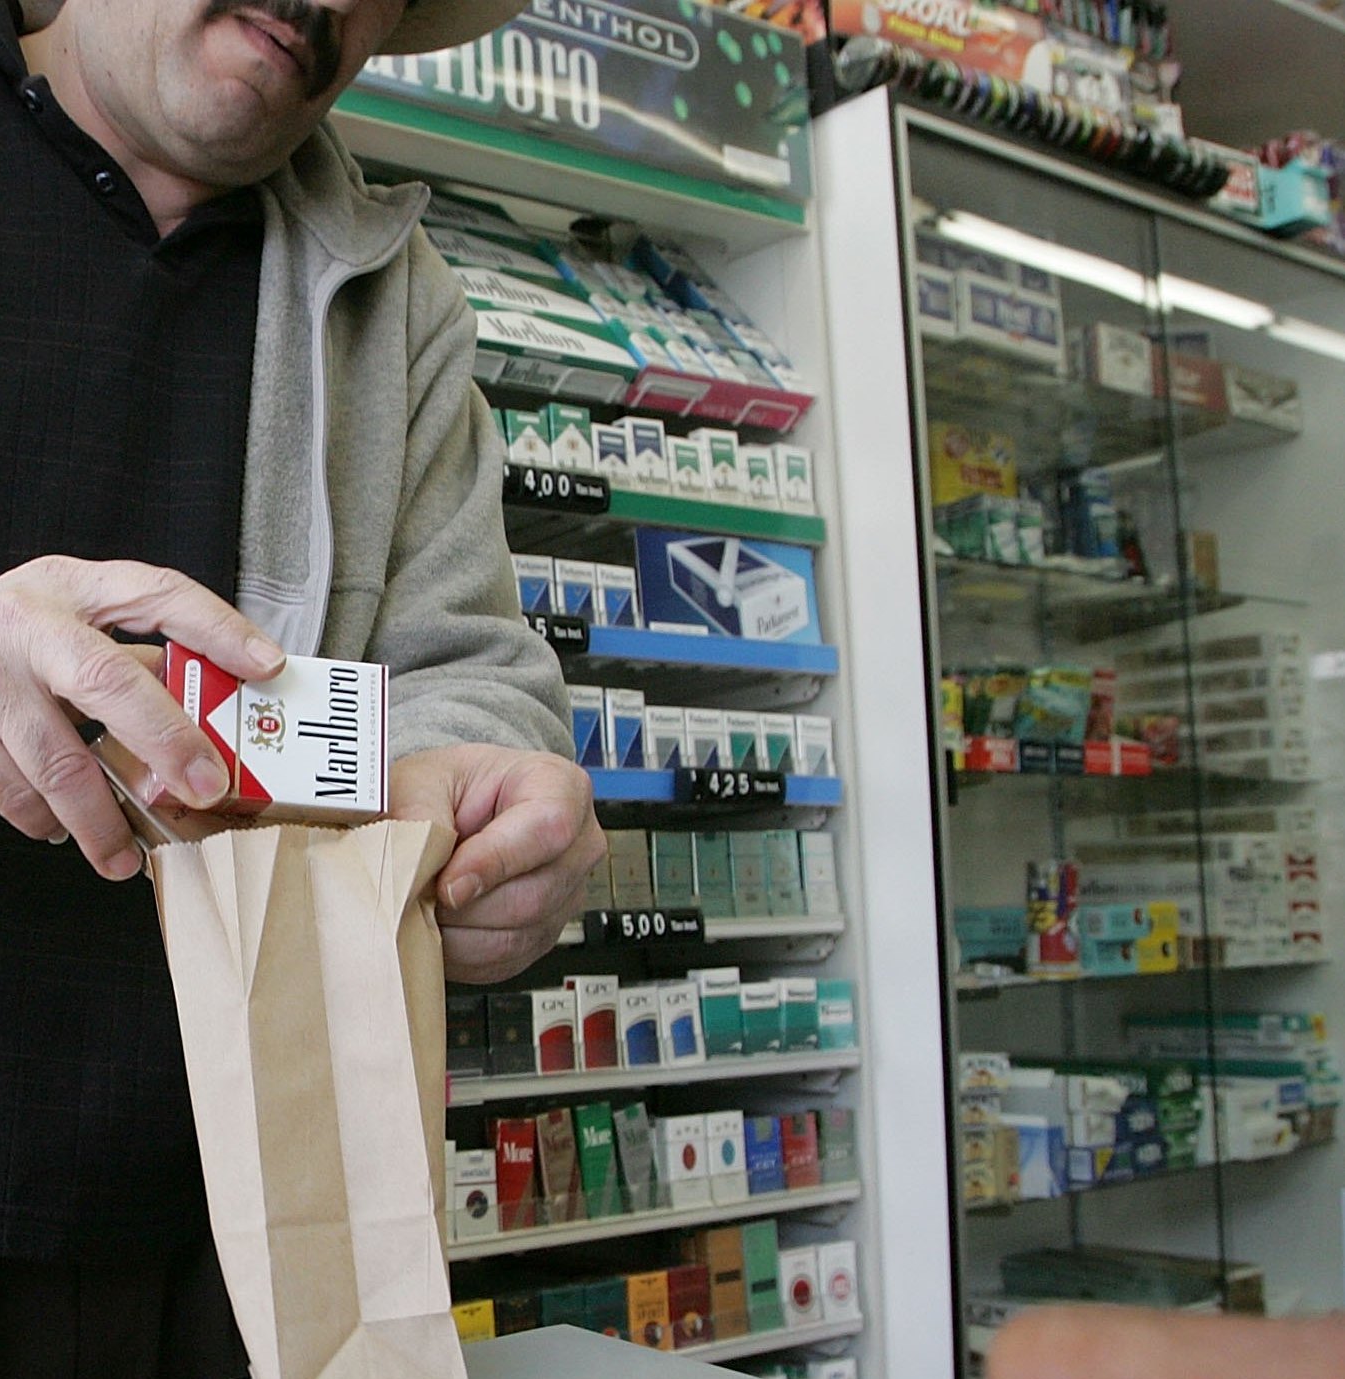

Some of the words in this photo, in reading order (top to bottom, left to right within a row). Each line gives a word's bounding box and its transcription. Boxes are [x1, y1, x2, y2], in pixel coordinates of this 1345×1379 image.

[533, 0, 687, 59] ENTHOL
[298, 666, 359, 803] Marlboro
[369, 671, 377, 736] CIGARETTES
